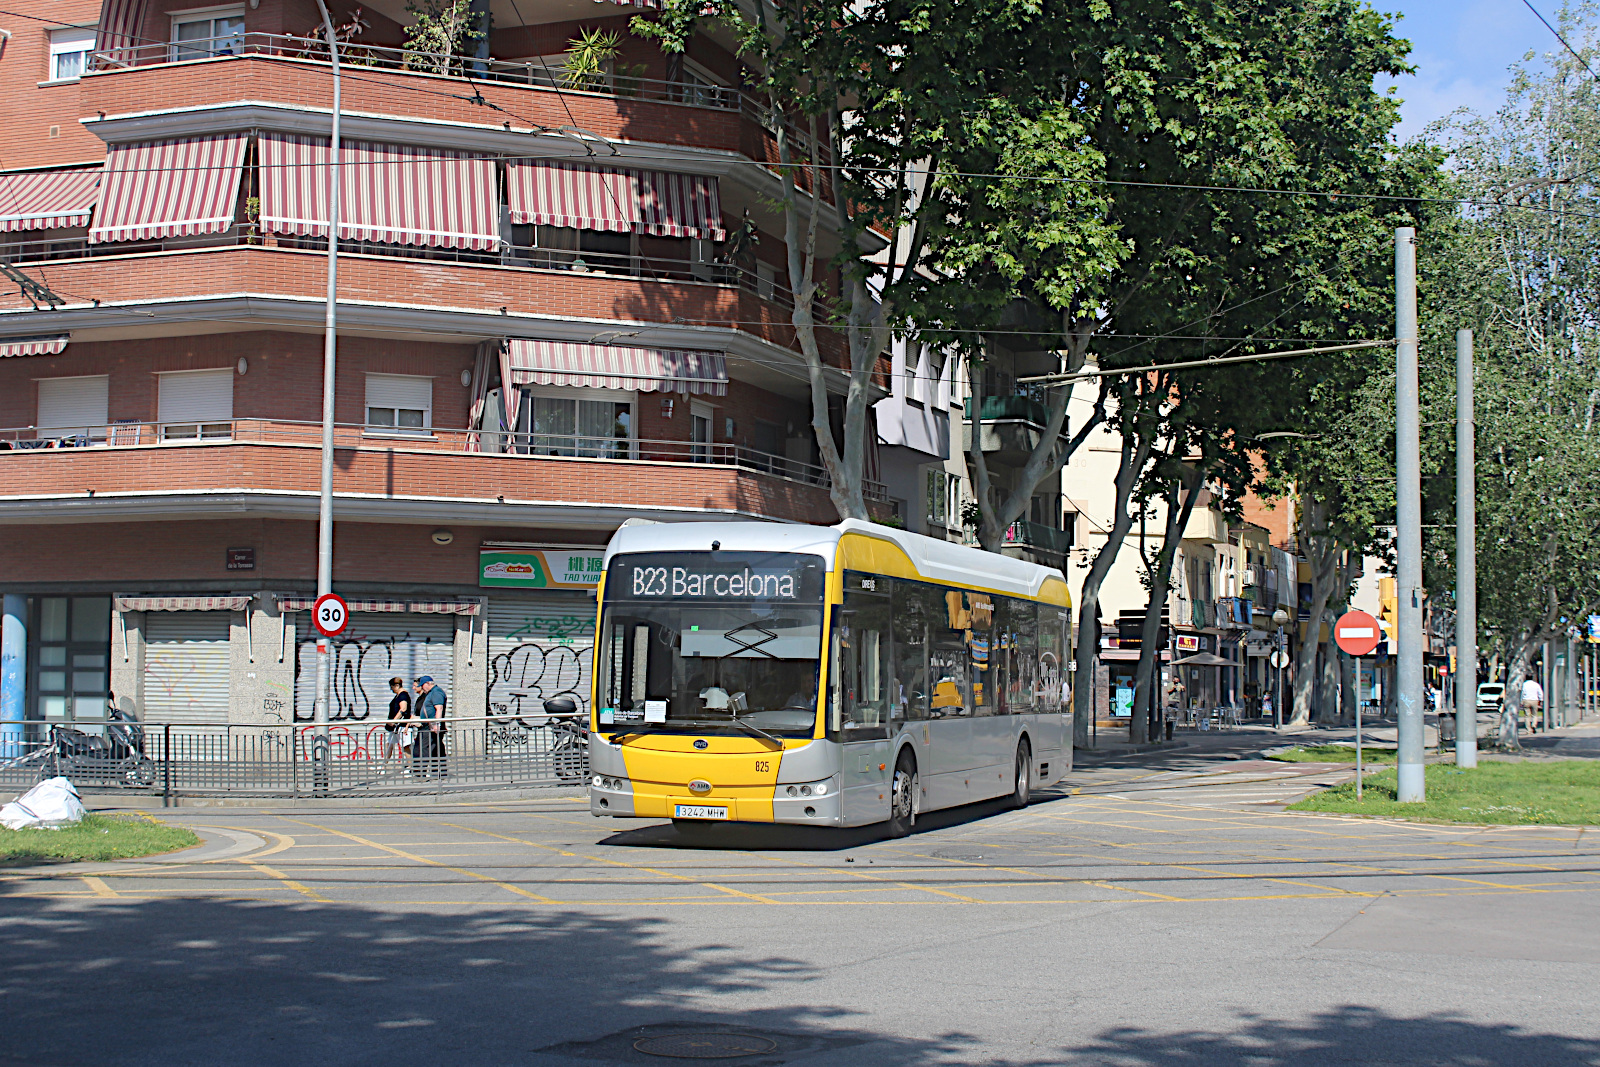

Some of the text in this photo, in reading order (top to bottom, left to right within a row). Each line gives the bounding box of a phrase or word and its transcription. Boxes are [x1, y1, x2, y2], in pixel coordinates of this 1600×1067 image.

[563, 573, 580, 582] TAO
[633, 567, 795, 597] B23 Barcelona
[321, 608, 341, 622] 30
[755, 761, 770, 773] 825
[681, 807, 725, 818] 3242 MHW
